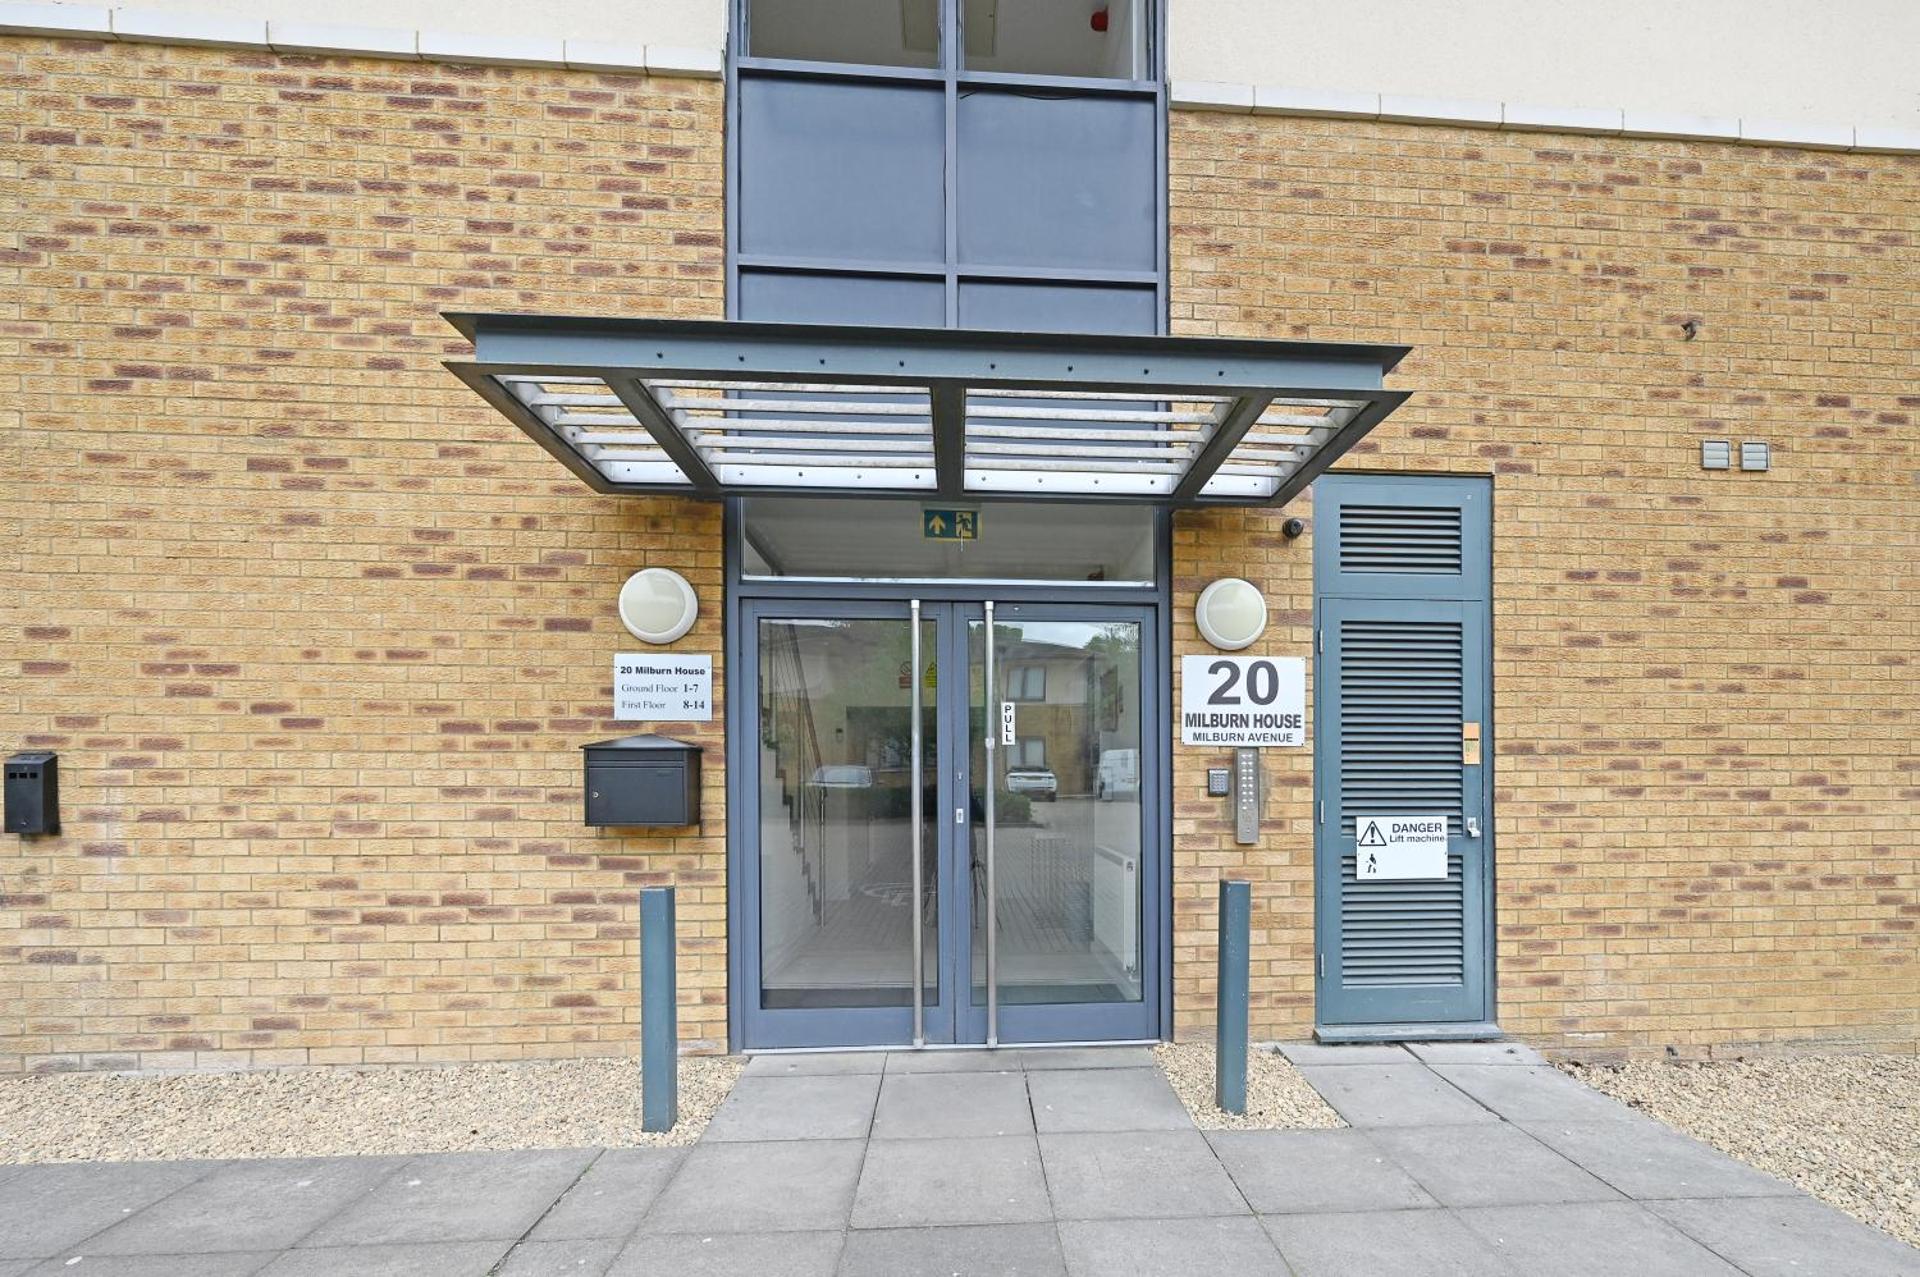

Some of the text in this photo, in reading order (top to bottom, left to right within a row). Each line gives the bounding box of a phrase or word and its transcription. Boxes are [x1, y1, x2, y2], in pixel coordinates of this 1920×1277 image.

[620, 666, 705, 675] 20 Milburn House
[621, 683, 699, 693] Ground Floor 1-7
[1207, 660, 1279, 706] 20
[621, 700, 705, 710] First Floor 8-14
[1004, 705, 1012, 742] PULL
[1185, 713, 1302, 729] MILBURN HOUSE
[1192, 733, 1293, 742] MILBURN AVENUE
[1392, 823, 1442, 833] DANGER
[1389, 835, 1445, 843] Lift machine
